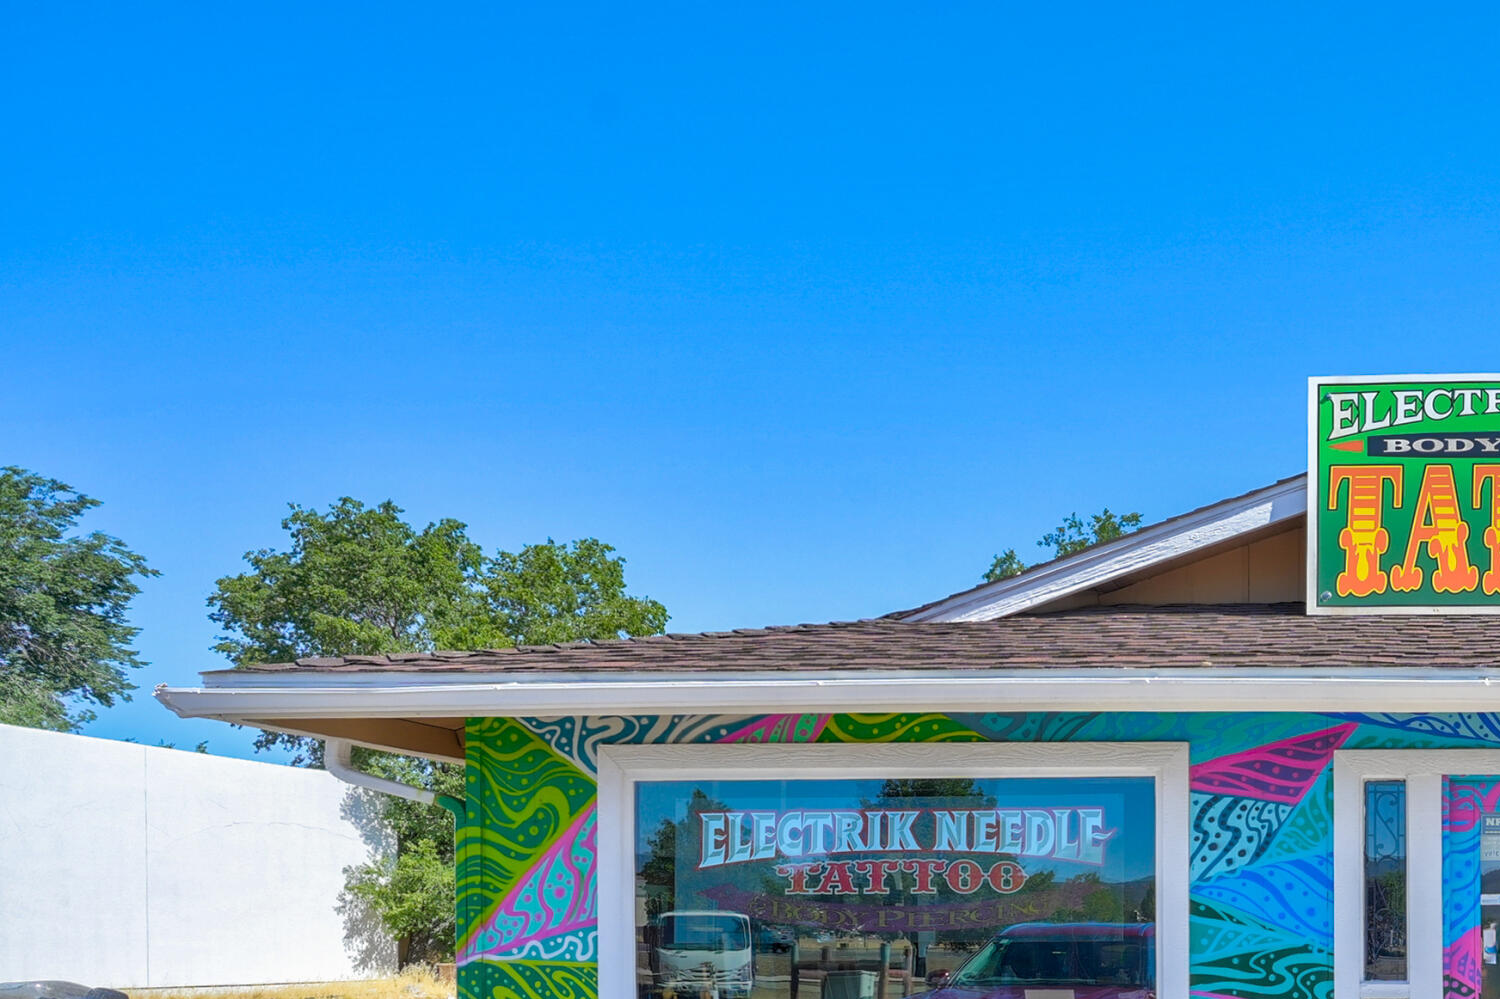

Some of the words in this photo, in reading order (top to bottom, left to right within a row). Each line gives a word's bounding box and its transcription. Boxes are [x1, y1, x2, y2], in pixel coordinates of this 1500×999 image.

[1383, 437, 1500, 452] BODY
[696, 810, 922, 869] ELECTRIK
[931, 808, 1113, 865] NEEDLE
[772, 859, 1029, 894] TATTOO
[771, 900, 866, 931] BODY
[878, 900, 1050, 928] PIERCING
